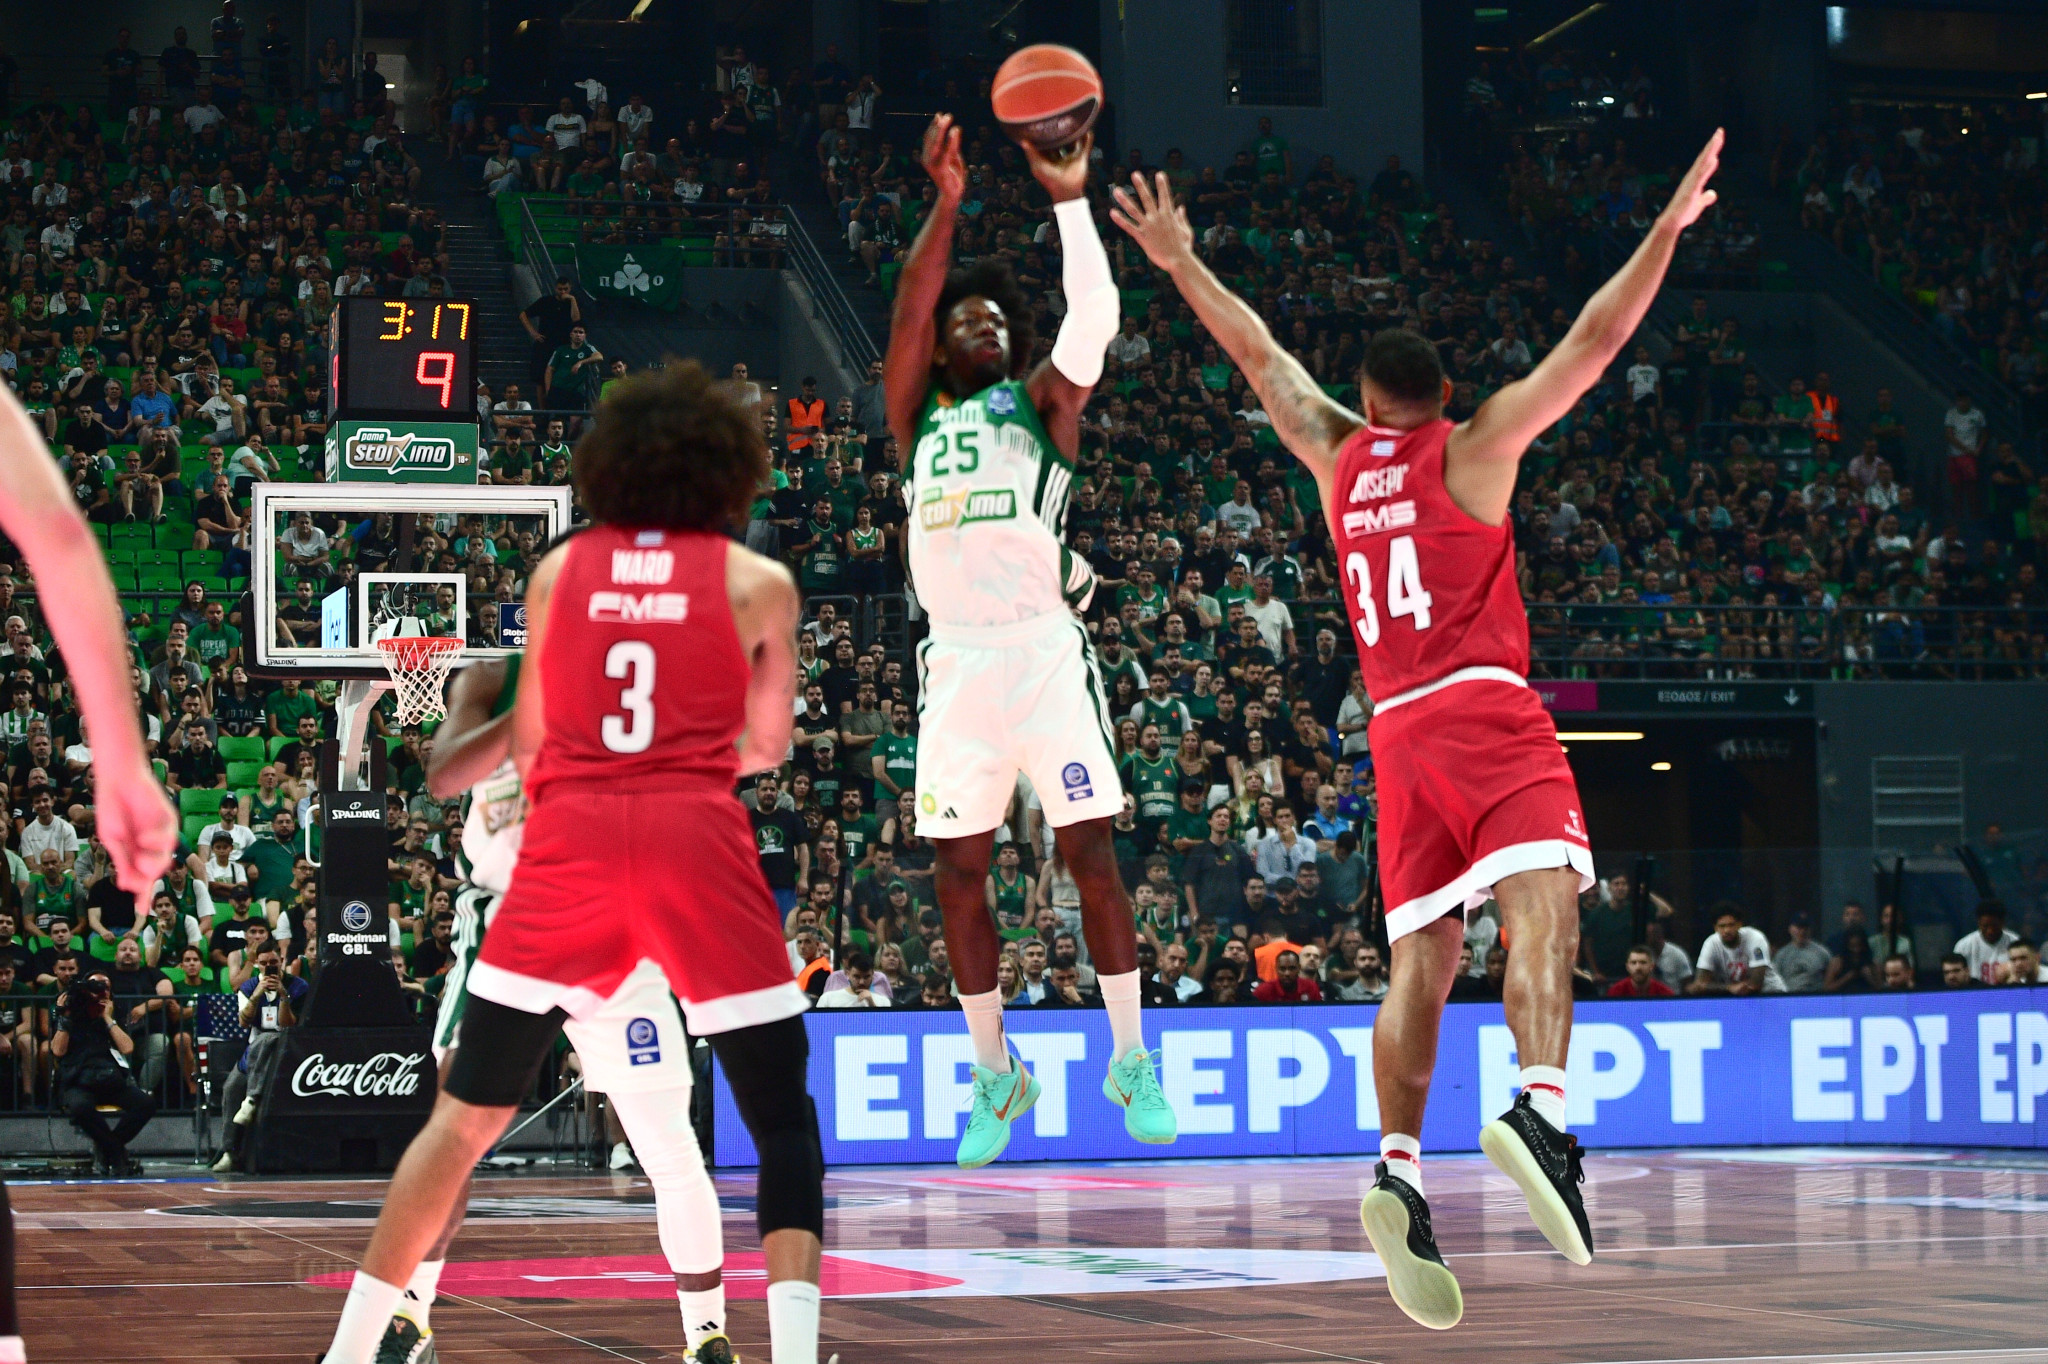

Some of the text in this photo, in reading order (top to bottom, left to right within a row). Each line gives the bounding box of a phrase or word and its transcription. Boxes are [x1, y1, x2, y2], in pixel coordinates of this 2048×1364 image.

[379, 302, 470, 340] 3:17
[416, 352, 455, 409] 9
[361, 433, 385, 442] pame
[931, 431, 979, 478] 25
[457, 455, 469, 464] 18+
[1342, 499, 1417, 537] FMS
[611, 549, 675, 585] WARD
[588, 591, 690, 622] FMS
[1346, 535, 1433, 648] 34
[502, 628, 528, 637] Stoixi
[513, 636, 528, 645] GB
[601, 640, 657, 754] 3
[332, 809, 381, 820] SPALDING
[327, 932, 387, 943] Stoiximan
[342, 943, 372, 955] GBL
[291, 1053, 427, 1097] Coca-Cola
[1978, 1011, 2048, 1124] ΕΡ
